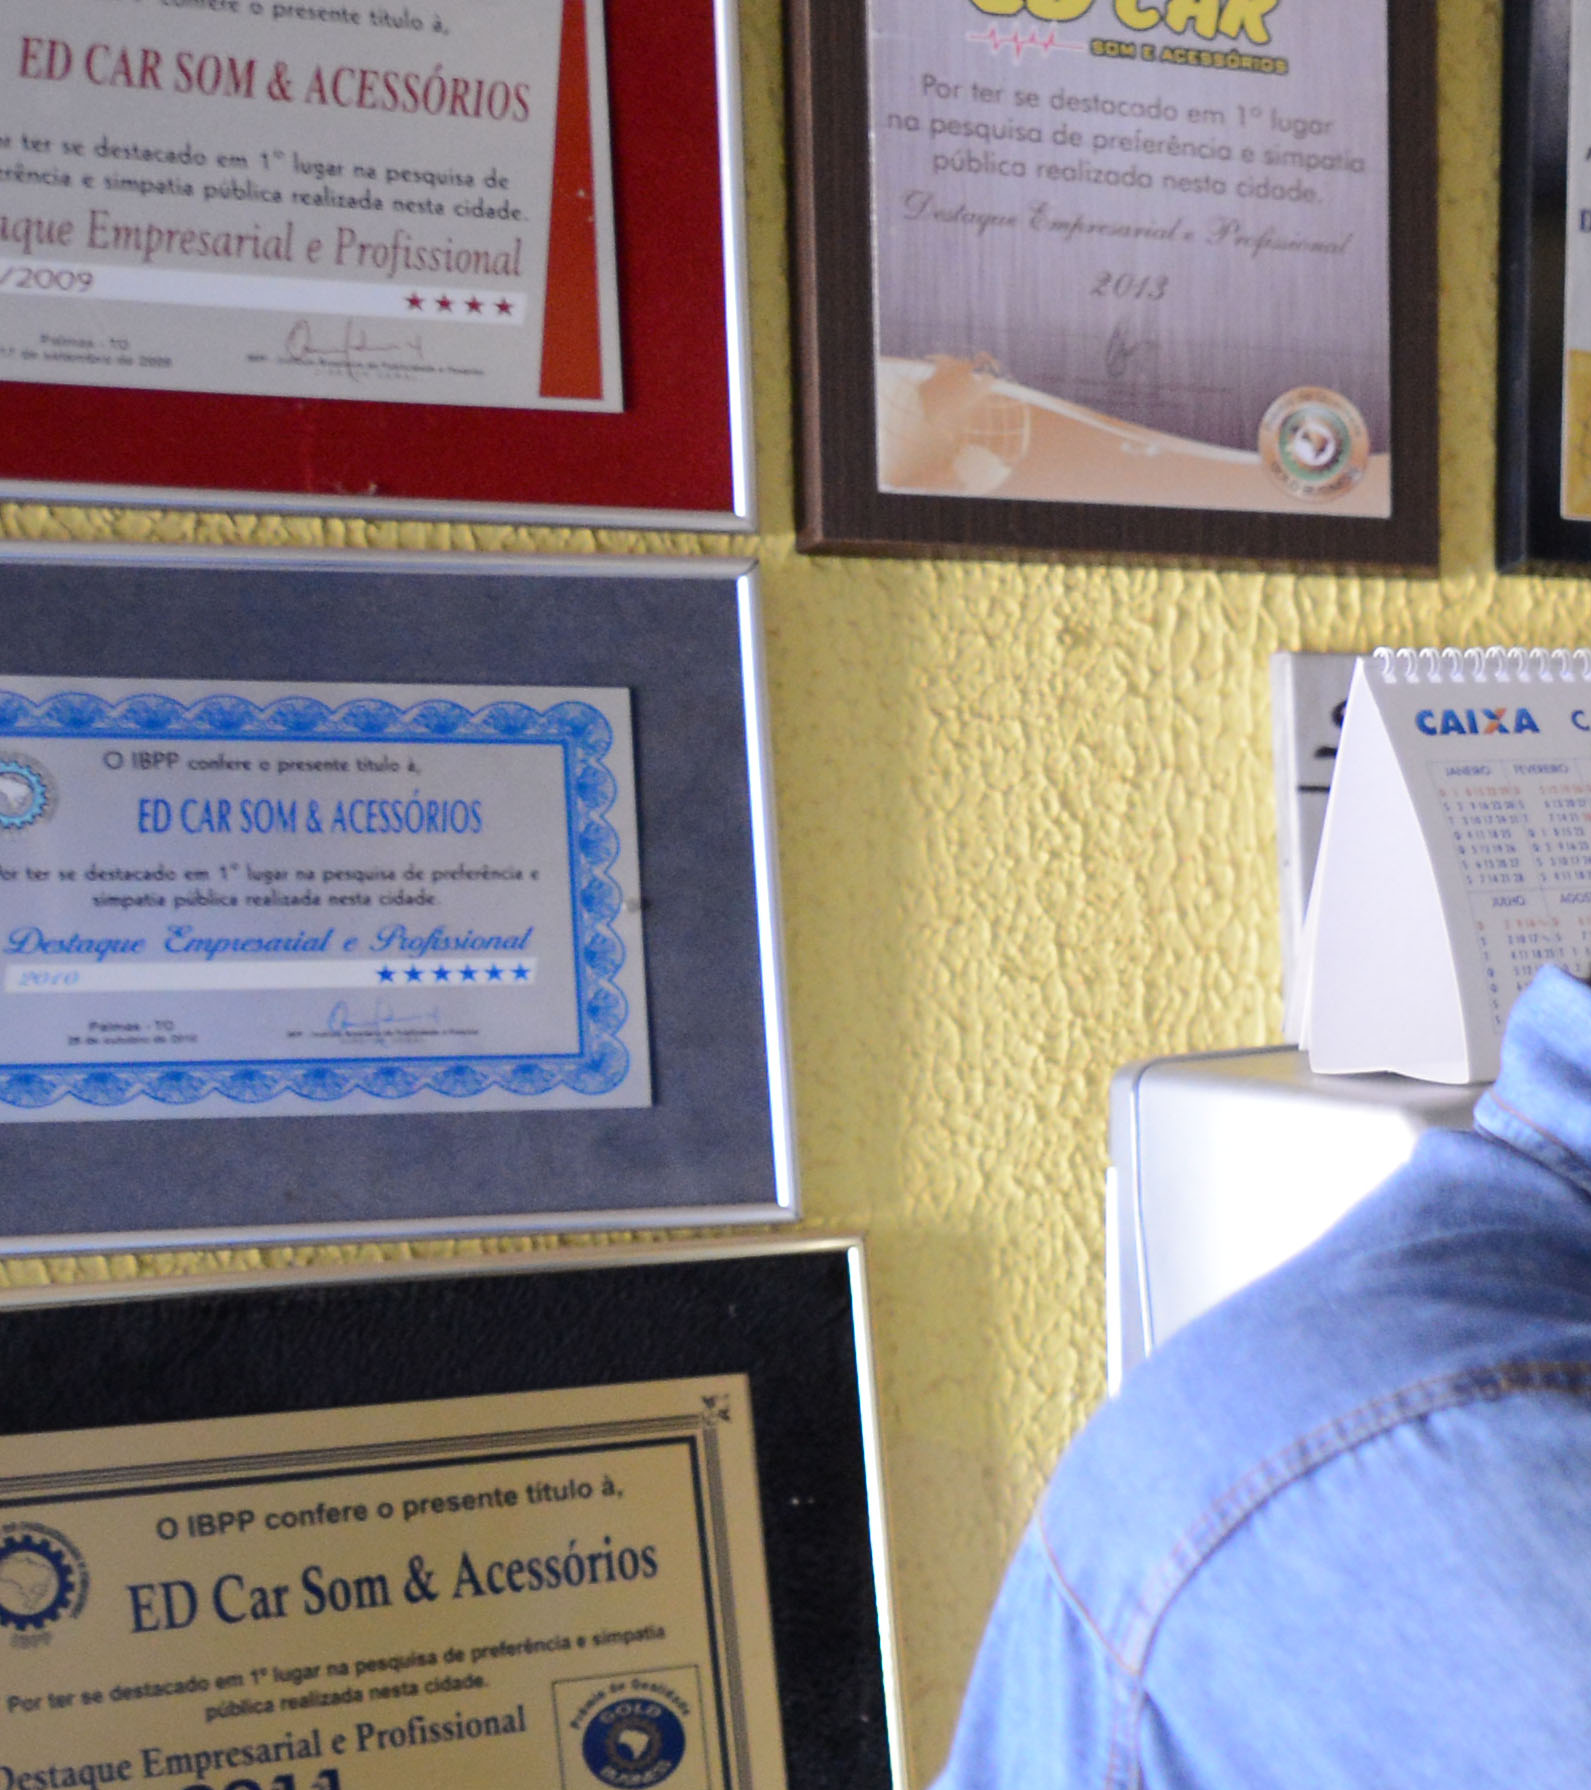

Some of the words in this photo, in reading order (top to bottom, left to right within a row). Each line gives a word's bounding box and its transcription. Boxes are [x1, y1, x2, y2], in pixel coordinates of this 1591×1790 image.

[1090, 37, 1136, 60] SOM
[19, 37, 72, 81] ED
[85, 43, 163, 90] CAR
[174, 51, 256, 98] SOM
[267, 60, 293, 102] &
[304, 62, 531, 122] ACESSÓRIOS
[921, 72, 962, 99] Por
[971, 82, 1003, 102] ter
[1014, 91, 1040, 108] se
[1050, 87, 1178, 122] destacado
[1187, 108, 1225, 125] em
[1270, 107, 1335, 140] lugar
[22, 133, 51, 152] ter
[62, 140, 84, 156] se
[94, 134, 206, 166] destacado
[217, 152, 248, 167] em
[293, 152, 343, 179] lugar
[354, 165, 376, 179] na
[385, 166, 475, 189] pesquisa
[484, 167, 509, 189] de
[887, 113, 920, 131] na
[929, 117, 1043, 144] pesquisa
[1052, 122, 1083, 147] de
[1092, 129, 1232, 162] preferência
[1241, 148, 1254, 163] e
[1264, 149, 1366, 174] simpatia
[81, 175, 95, 188] e
[104, 174, 194, 196] simpatia
[292, 186, 383, 211] realizada
[392, 198, 444, 215] nesta
[932, 149, 1027, 177] pública
[1036, 159, 1153, 189] realizada
[1162, 175, 1227, 196] nesta
[901, 189, 1017, 236] Destaque
[87, 208, 293, 264] Empresarial
[306, 237, 322, 264] e
[334, 226, 522, 279] Profissional
[1091, 271, 1169, 301] 2013
[1415, 707, 1540, 736] CAIXA
[103, 751, 124, 770] O
[132, 751, 180, 770] IBPP
[277, 758, 350, 774] presente
[138, 798, 172, 834] ED
[181, 798, 232, 834] CAR
[240, 798, 297, 834] SOM
[306, 799, 323, 834] &
[331, 788, 483, 834] ACESSÓRIOS
[26, 867, 49, 881] ter
[59, 870, 76, 881] se
[85, 863, 176, 882] destacado
[185, 870, 209, 881] em
[247, 864, 288, 884] lugar
[296, 869, 315, 881] na
[323, 866, 396, 884] pesquisa
[403, 863, 424, 881] de
[432, 863, 523, 885] preferência
[93, 892, 165, 911] simpatia
[246, 889, 321, 906] realizada
[329, 891, 371, 906] nesta
[6, 926, 147, 962] Destaque
[164, 924, 335, 961] Empresarial
[343, 935, 358, 951] e
[370, 923, 534, 958] Profissional
[156, 1516, 178, 1540] O
[188, 1509, 255, 1538] IBPP
[265, 1503, 368, 1530] confere
[377, 1502, 394, 1519] o
[403, 1488, 518, 1522] presente
[126, 1579, 198, 1634] ED
[213, 1573, 289, 1625] Car
[301, 1564, 393, 1616] Som
[403, 1554, 439, 1604] &
[453, 1535, 659, 1599] Acessórios
[7, 1693, 41, 1713] Por
[48, 1692, 75, 1709] ter
[81, 1689, 103, 1705] se
[109, 1674, 210, 1702] destacado
[215, 1672, 244, 1691] em
[273, 1662, 321, 1686] lugar
[326, 1661, 350, 1676] na
[355, 1648, 438, 1678] pesquisa
[443, 1646, 466, 1664] de
[470, 1634, 571, 1664] preferência
[576, 1633, 586, 1648] e
[592, 1623, 666, 1649] simpatia
[205, 1698, 275, 1724] pública
[280, 1684, 364, 1711] realizada
[369, 1679, 418, 1701] nesta
[140, 1729, 323, 1780] Empresarial
[331, 1731, 347, 1755] e
[355, 1704, 528, 1752] Profissional
